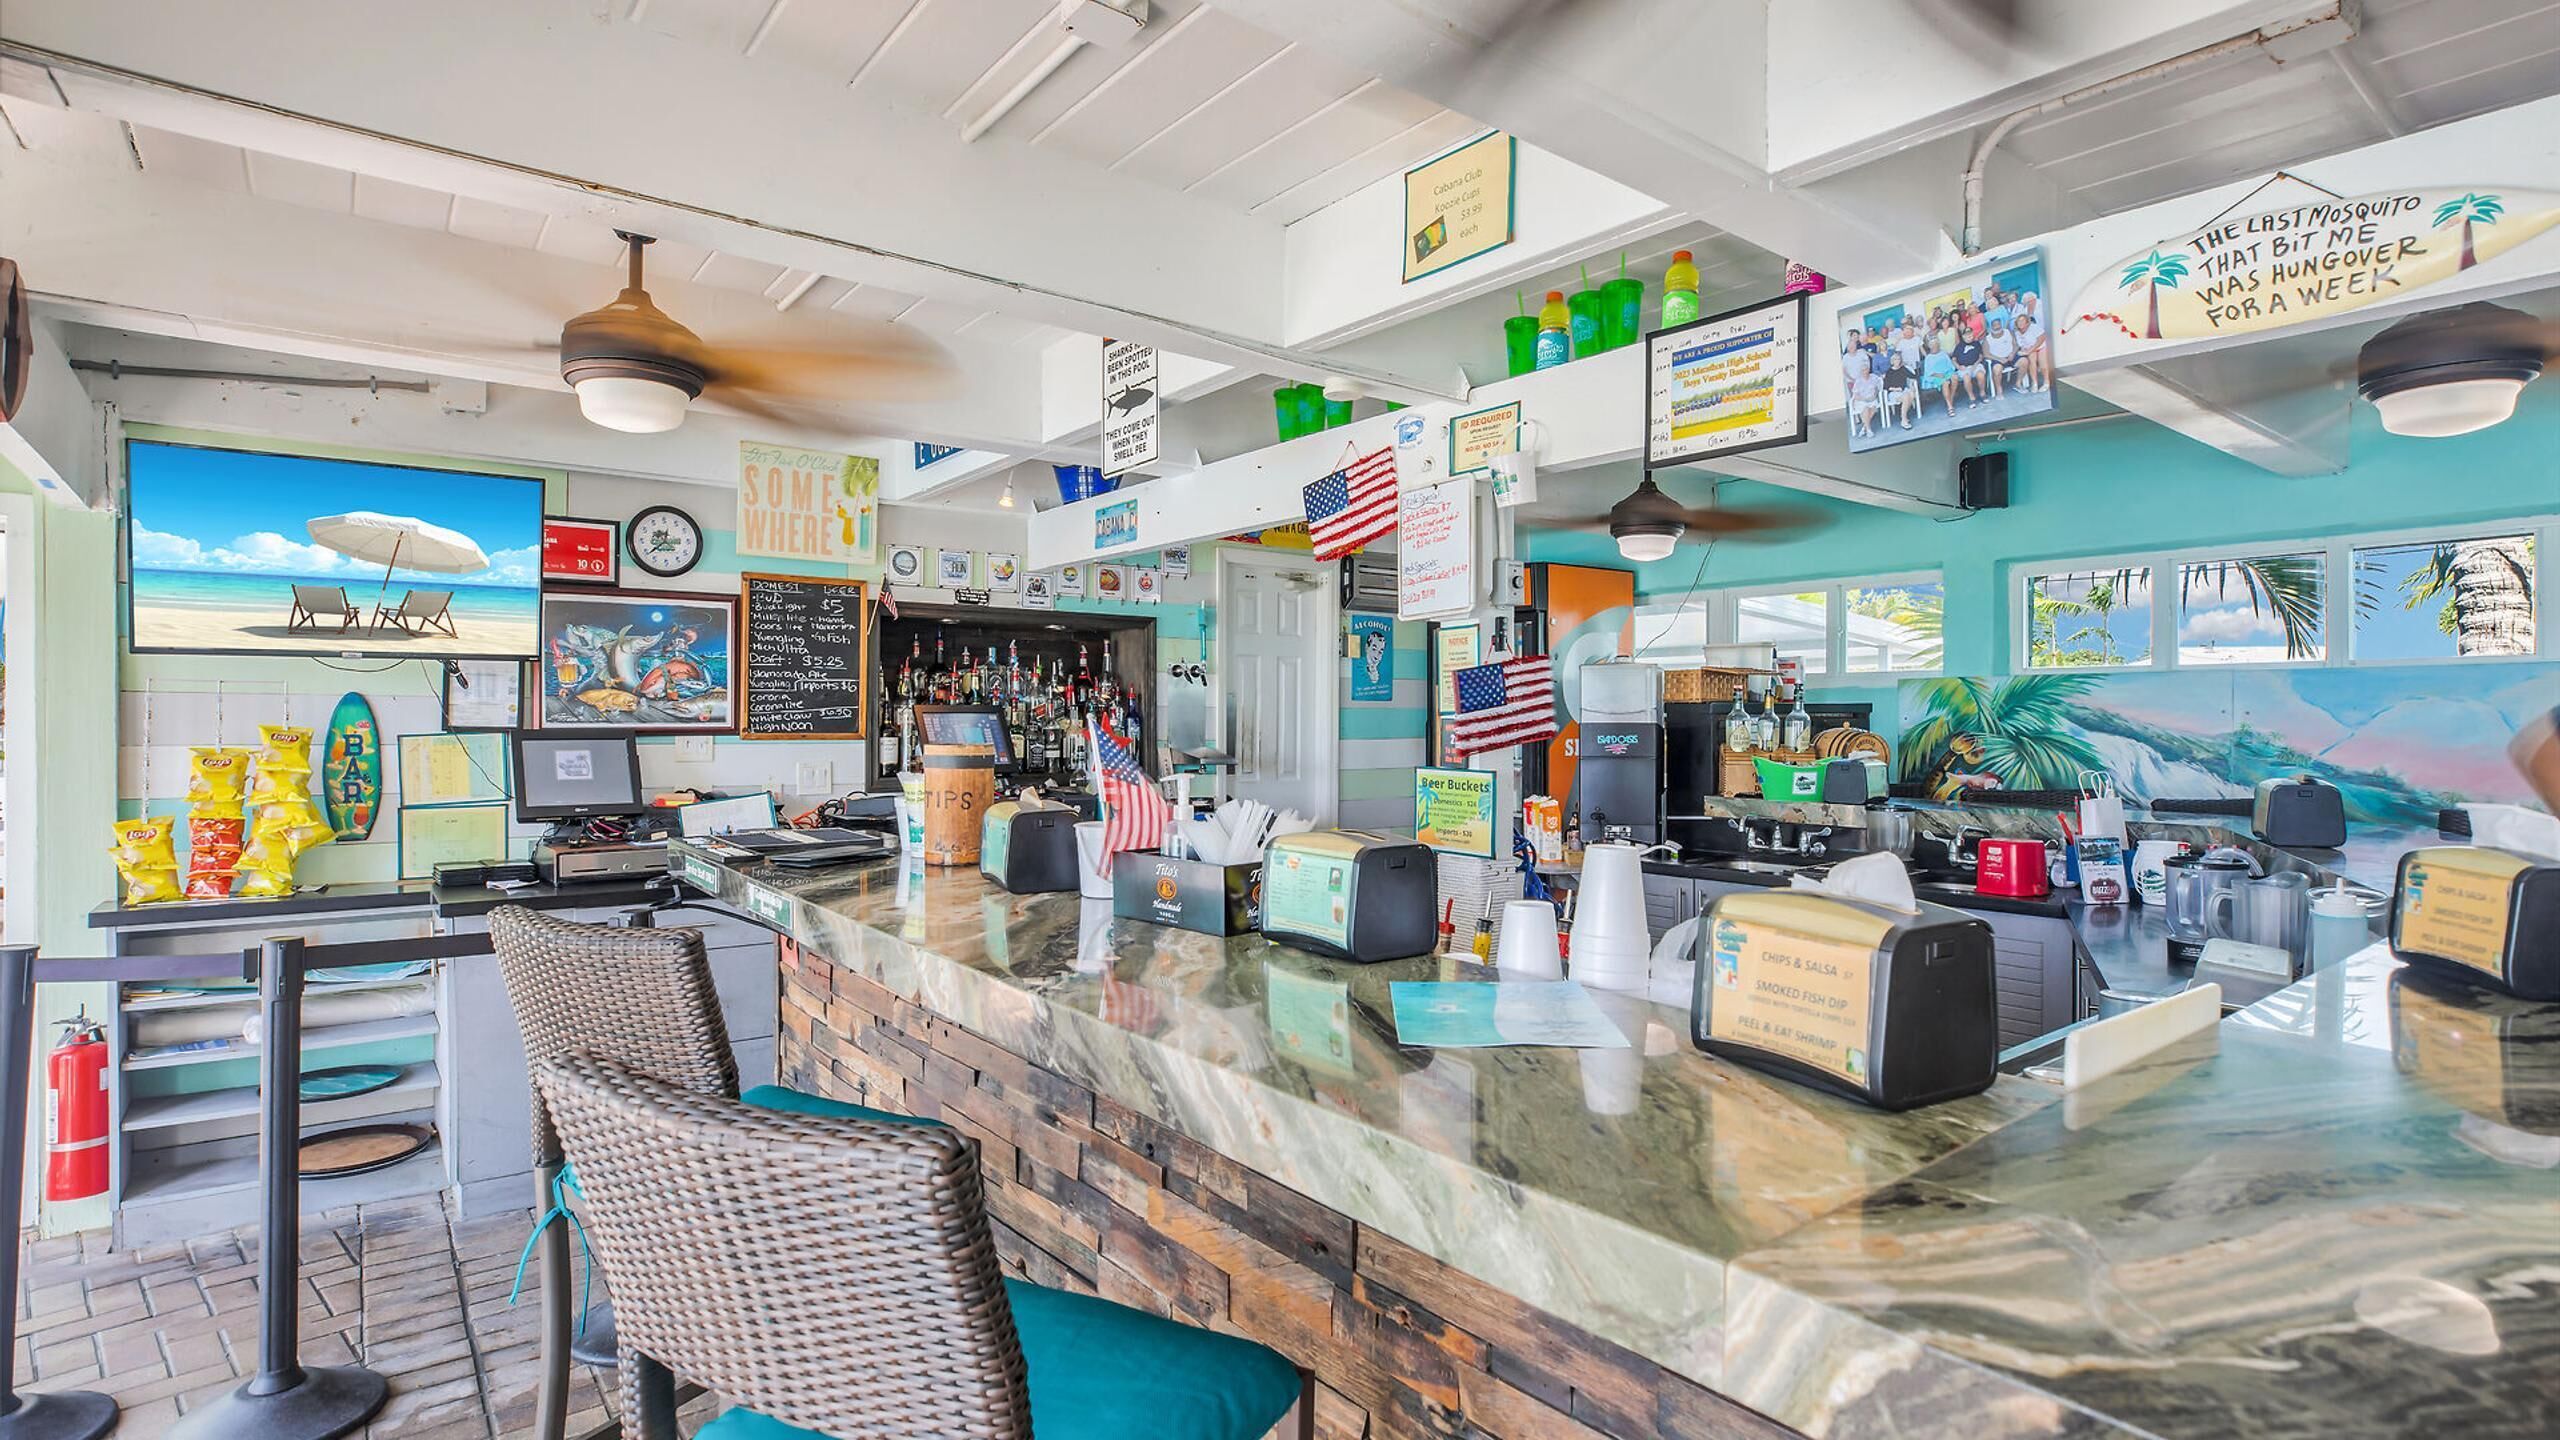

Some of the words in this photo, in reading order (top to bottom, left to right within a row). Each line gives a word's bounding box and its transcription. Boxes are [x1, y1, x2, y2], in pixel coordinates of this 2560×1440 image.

[1433, 178, 1463, 197] Cabana
[1464, 168, 1483, 184] Club
[1434, 198, 1461, 215] Koozie
[1459, 225, 1479, 239] each
[2187, 224, 2239, 254] THE
[2247, 208, 2307, 233] LAST
[2199, 242, 2262, 278] THAT
[2328, 223, 2379, 249] ME
[2196, 269, 2261, 305] WAS
[2272, 236, 2428, 285] HUNGOVER
[2206, 298, 2261, 327] FOR
[2269, 293, 2288, 314] A
[2298, 264, 2401, 306] WEEK
[1107, 359, 1124, 374] BEEN
[1124, 346, 1153, 366] SPOTTED
[1109, 344, 1133, 362] SHARKS
[1692, 360, 1726, 377] Marathon
[1727, 356, 1745, 370] High
[1746, 349, 1772, 363] School
[1109, 375, 1117, 385] IN
[1118, 367, 1132, 380] THIS
[1134, 361, 1150, 373] POOL
[1683, 377, 1701, 389] Boys
[1702, 371, 1727, 384] Varsity
[1729, 362, 1760, 377] Baseball
[1106, 428, 1122, 442] THEY
[1123, 420, 1140, 435] COME
[1141, 415, 1155, 427] OUT
[1470, 410, 1513, 428] REQUIRED
[1112, 437, 1131, 450] WHEN
[1132, 429, 1149, 444] THEY
[1114, 448, 1134, 462] SMELL
[1135, 442, 1147, 456] PEE
[744, 463, 835, 514] SOME
[743, 509, 833, 556] WHERE
[1096, 514, 1126, 538] CABANA
[820, 598, 845, 614] $5
[754, 631, 806, 647] Yuengling
[803, 655, 845, 668] $5.25
[840, 680, 858, 693] $6
[784, 712, 812, 721] Claw
[750, 723, 781, 734] High
[1422, 777, 1445, 789] Beer
[1447, 779, 1490, 793] Buckets
[925, 790, 974, 811] TIPS
[1433, 798, 1463, 808] Domestics
[1435, 826, 1459, 836] Imports
[1155, 863, 1179, 879] Tito's
[1762, 951, 1792, 967] CHIPS
[1793, 958, 1802, 969] &
[1804, 959, 1838, 977] SALSA
[1755, 980, 1800, 999] SMOKED
[1802, 991, 1825, 1006] FISH
[1828, 997, 1849, 1010] DIP
[1738, 1014, 1760, 1030] PEEL
[1762, 1021, 1771, 1033] &
[1774, 1024, 1793, 1037] EAT
[1794, 1030, 1838, 1050] SHRIMP
